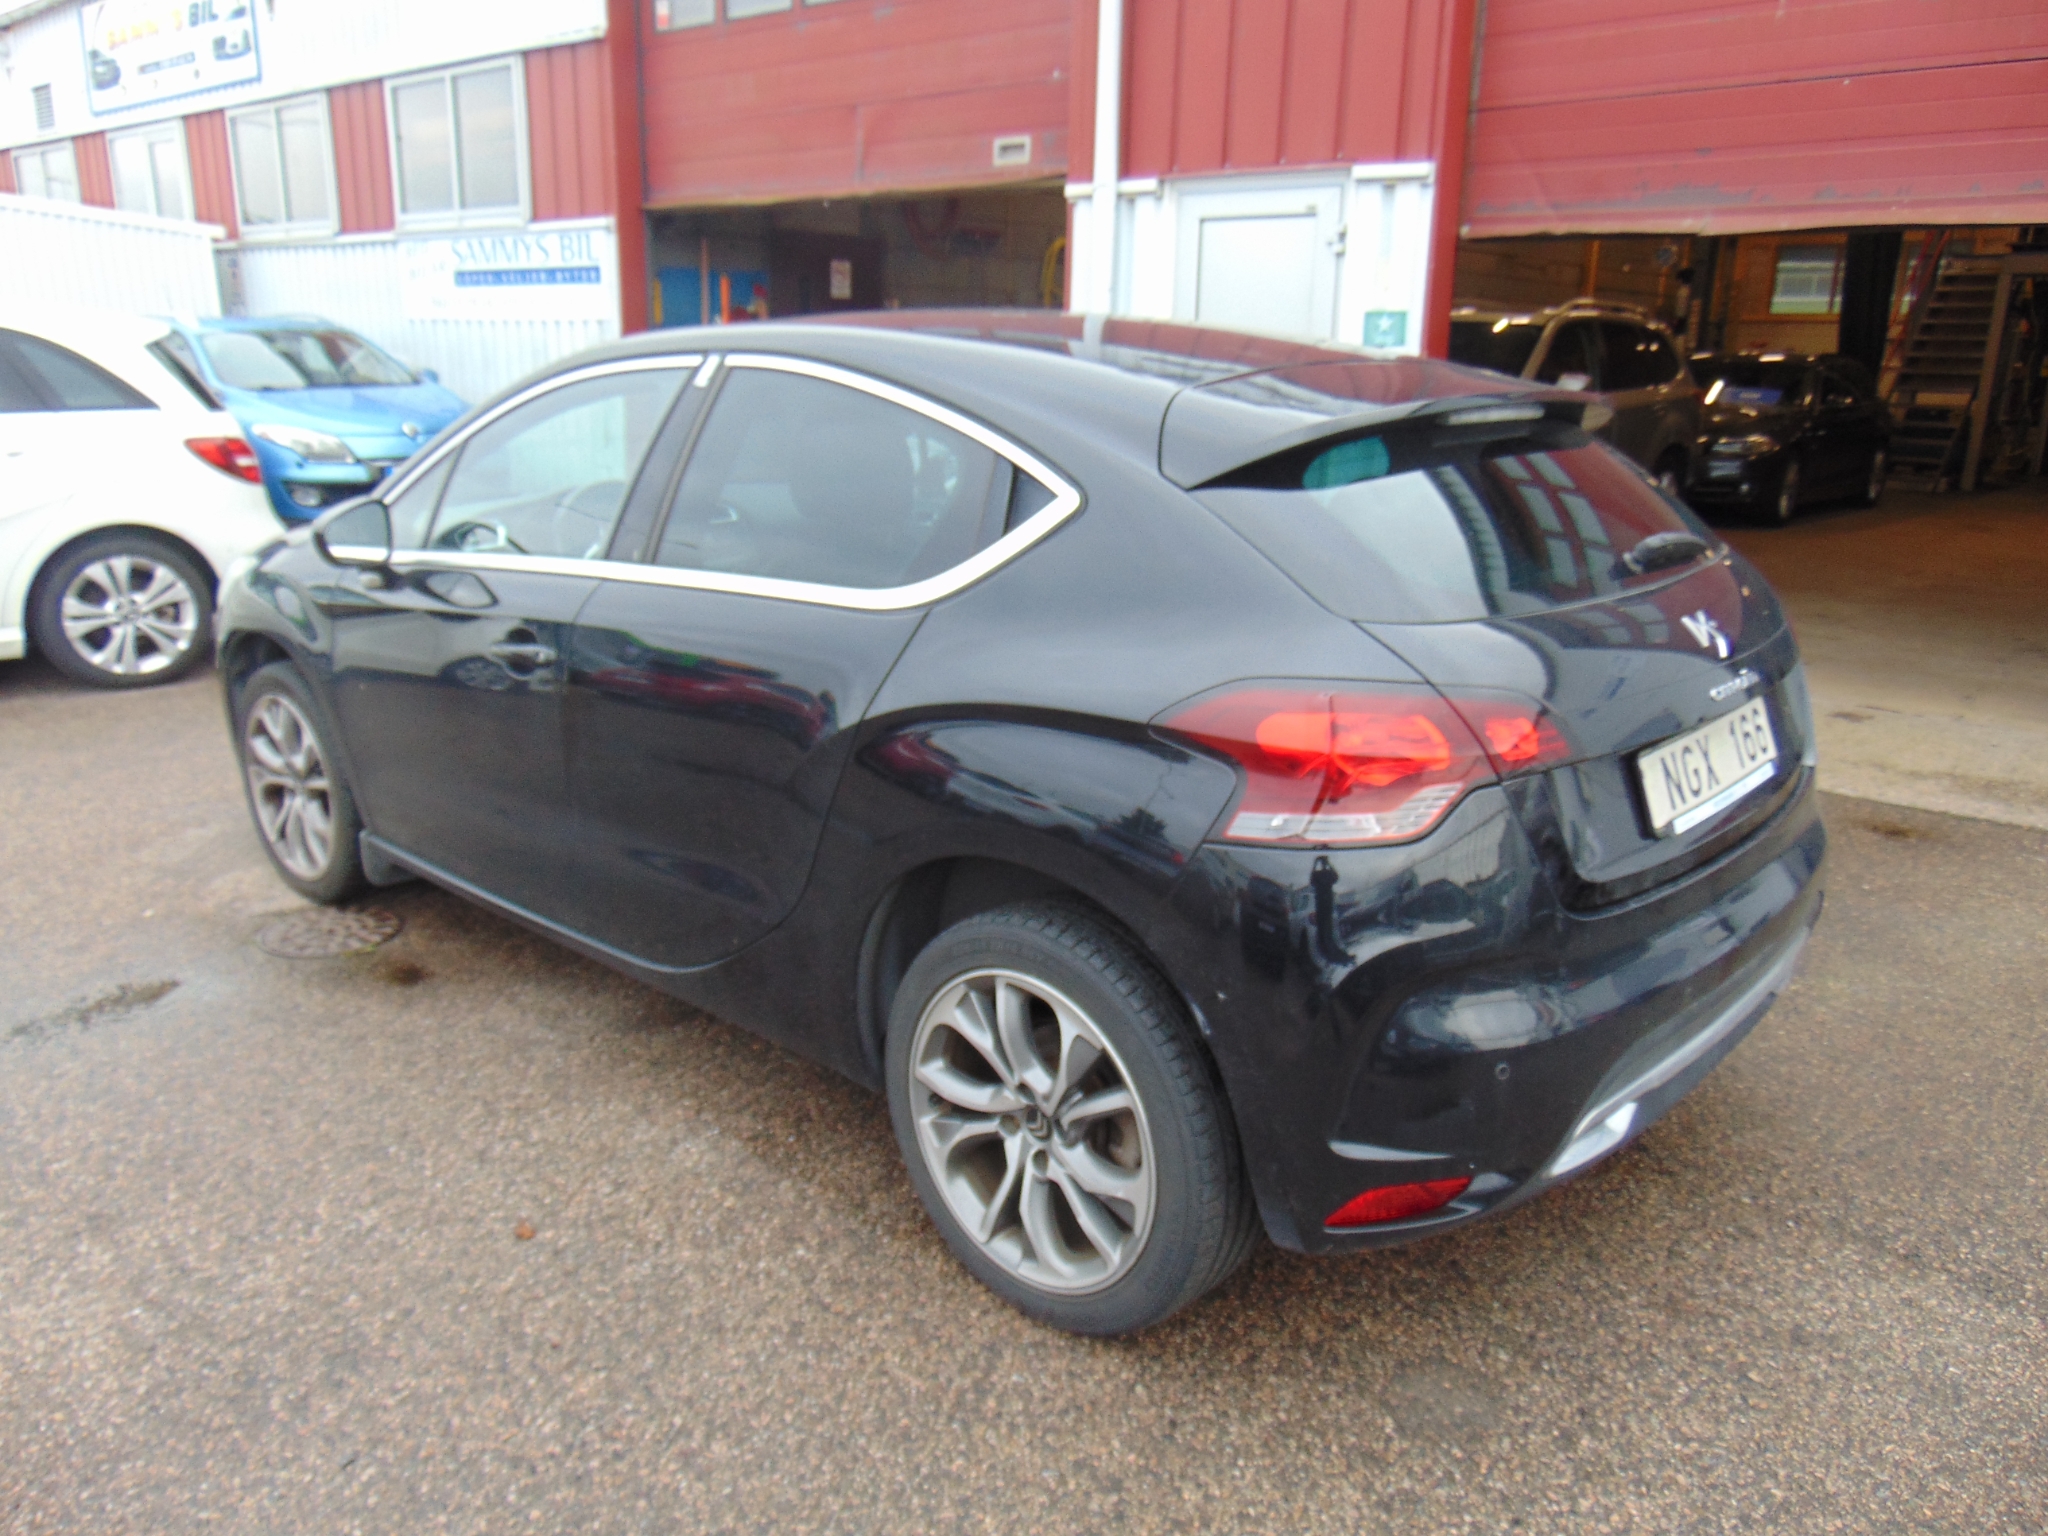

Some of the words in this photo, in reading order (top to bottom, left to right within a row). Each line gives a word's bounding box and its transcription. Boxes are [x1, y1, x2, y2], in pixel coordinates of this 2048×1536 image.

[188, 0, 219, 28] BIL
[559, 231, 600, 263] BIL
[1660, 735, 1720, 811] NGX
[1729, 707, 1769, 769] 166
